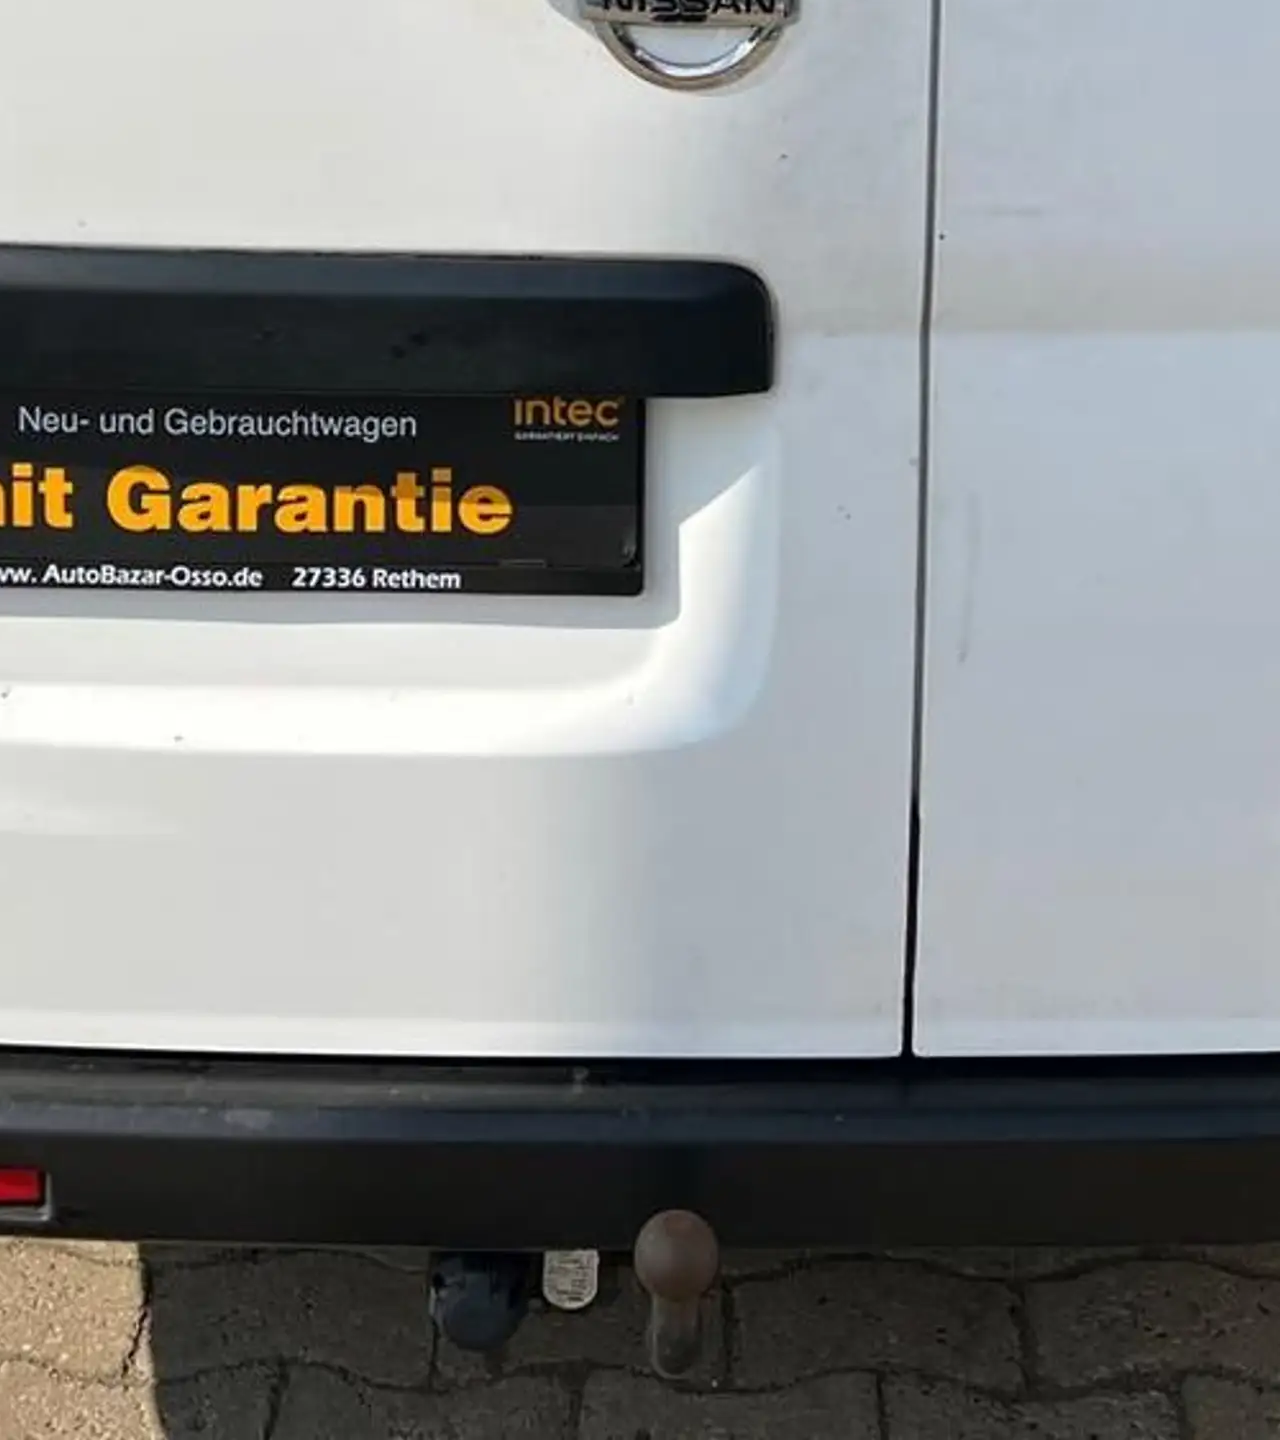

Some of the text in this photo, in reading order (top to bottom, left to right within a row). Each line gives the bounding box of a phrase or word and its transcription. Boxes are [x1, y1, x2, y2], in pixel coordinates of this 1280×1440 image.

[19, 406, 417, 443] Neu- und Gebrauchtwagen
[513, 396, 620, 427] intec
[106, 464, 514, 536] Garantie
[291, 566, 366, 588] 27336
[372, 567, 462, 589] Rethem
